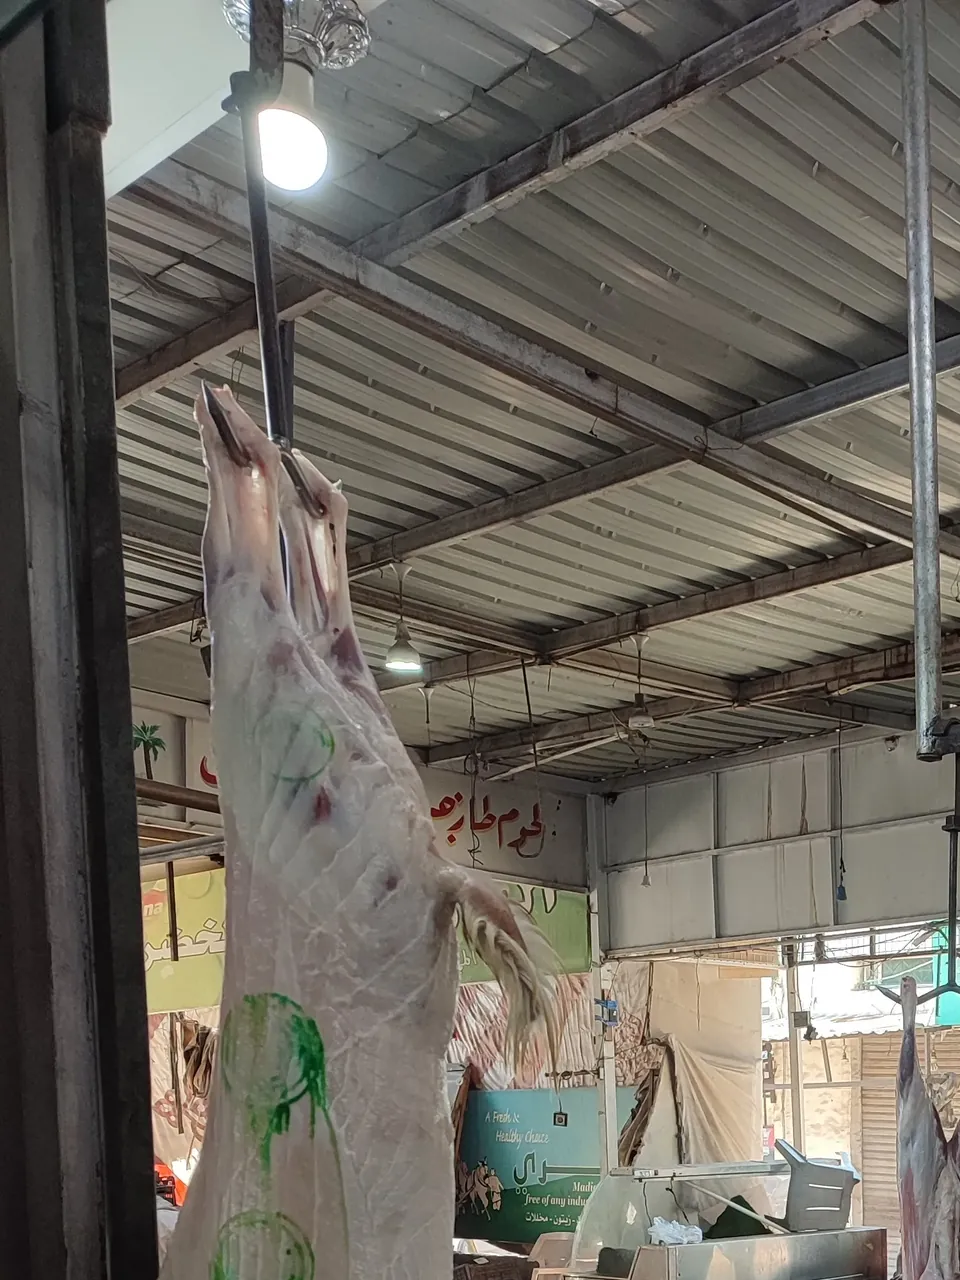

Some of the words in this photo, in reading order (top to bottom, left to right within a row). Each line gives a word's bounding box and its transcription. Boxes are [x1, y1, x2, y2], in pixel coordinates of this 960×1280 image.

[499, 803, 543, 849] لحوم
[485, 1113, 491, 1123] A
[492, 1108, 511, 1124] Fresh
[495, 1129, 523, 1150] Healthy
[524, 1130, 549, 1144] Choice
[524, 1192, 541, 1206] free
[541, 1193, 550, 1207] of
[550, 1197, 566, 1208] any
